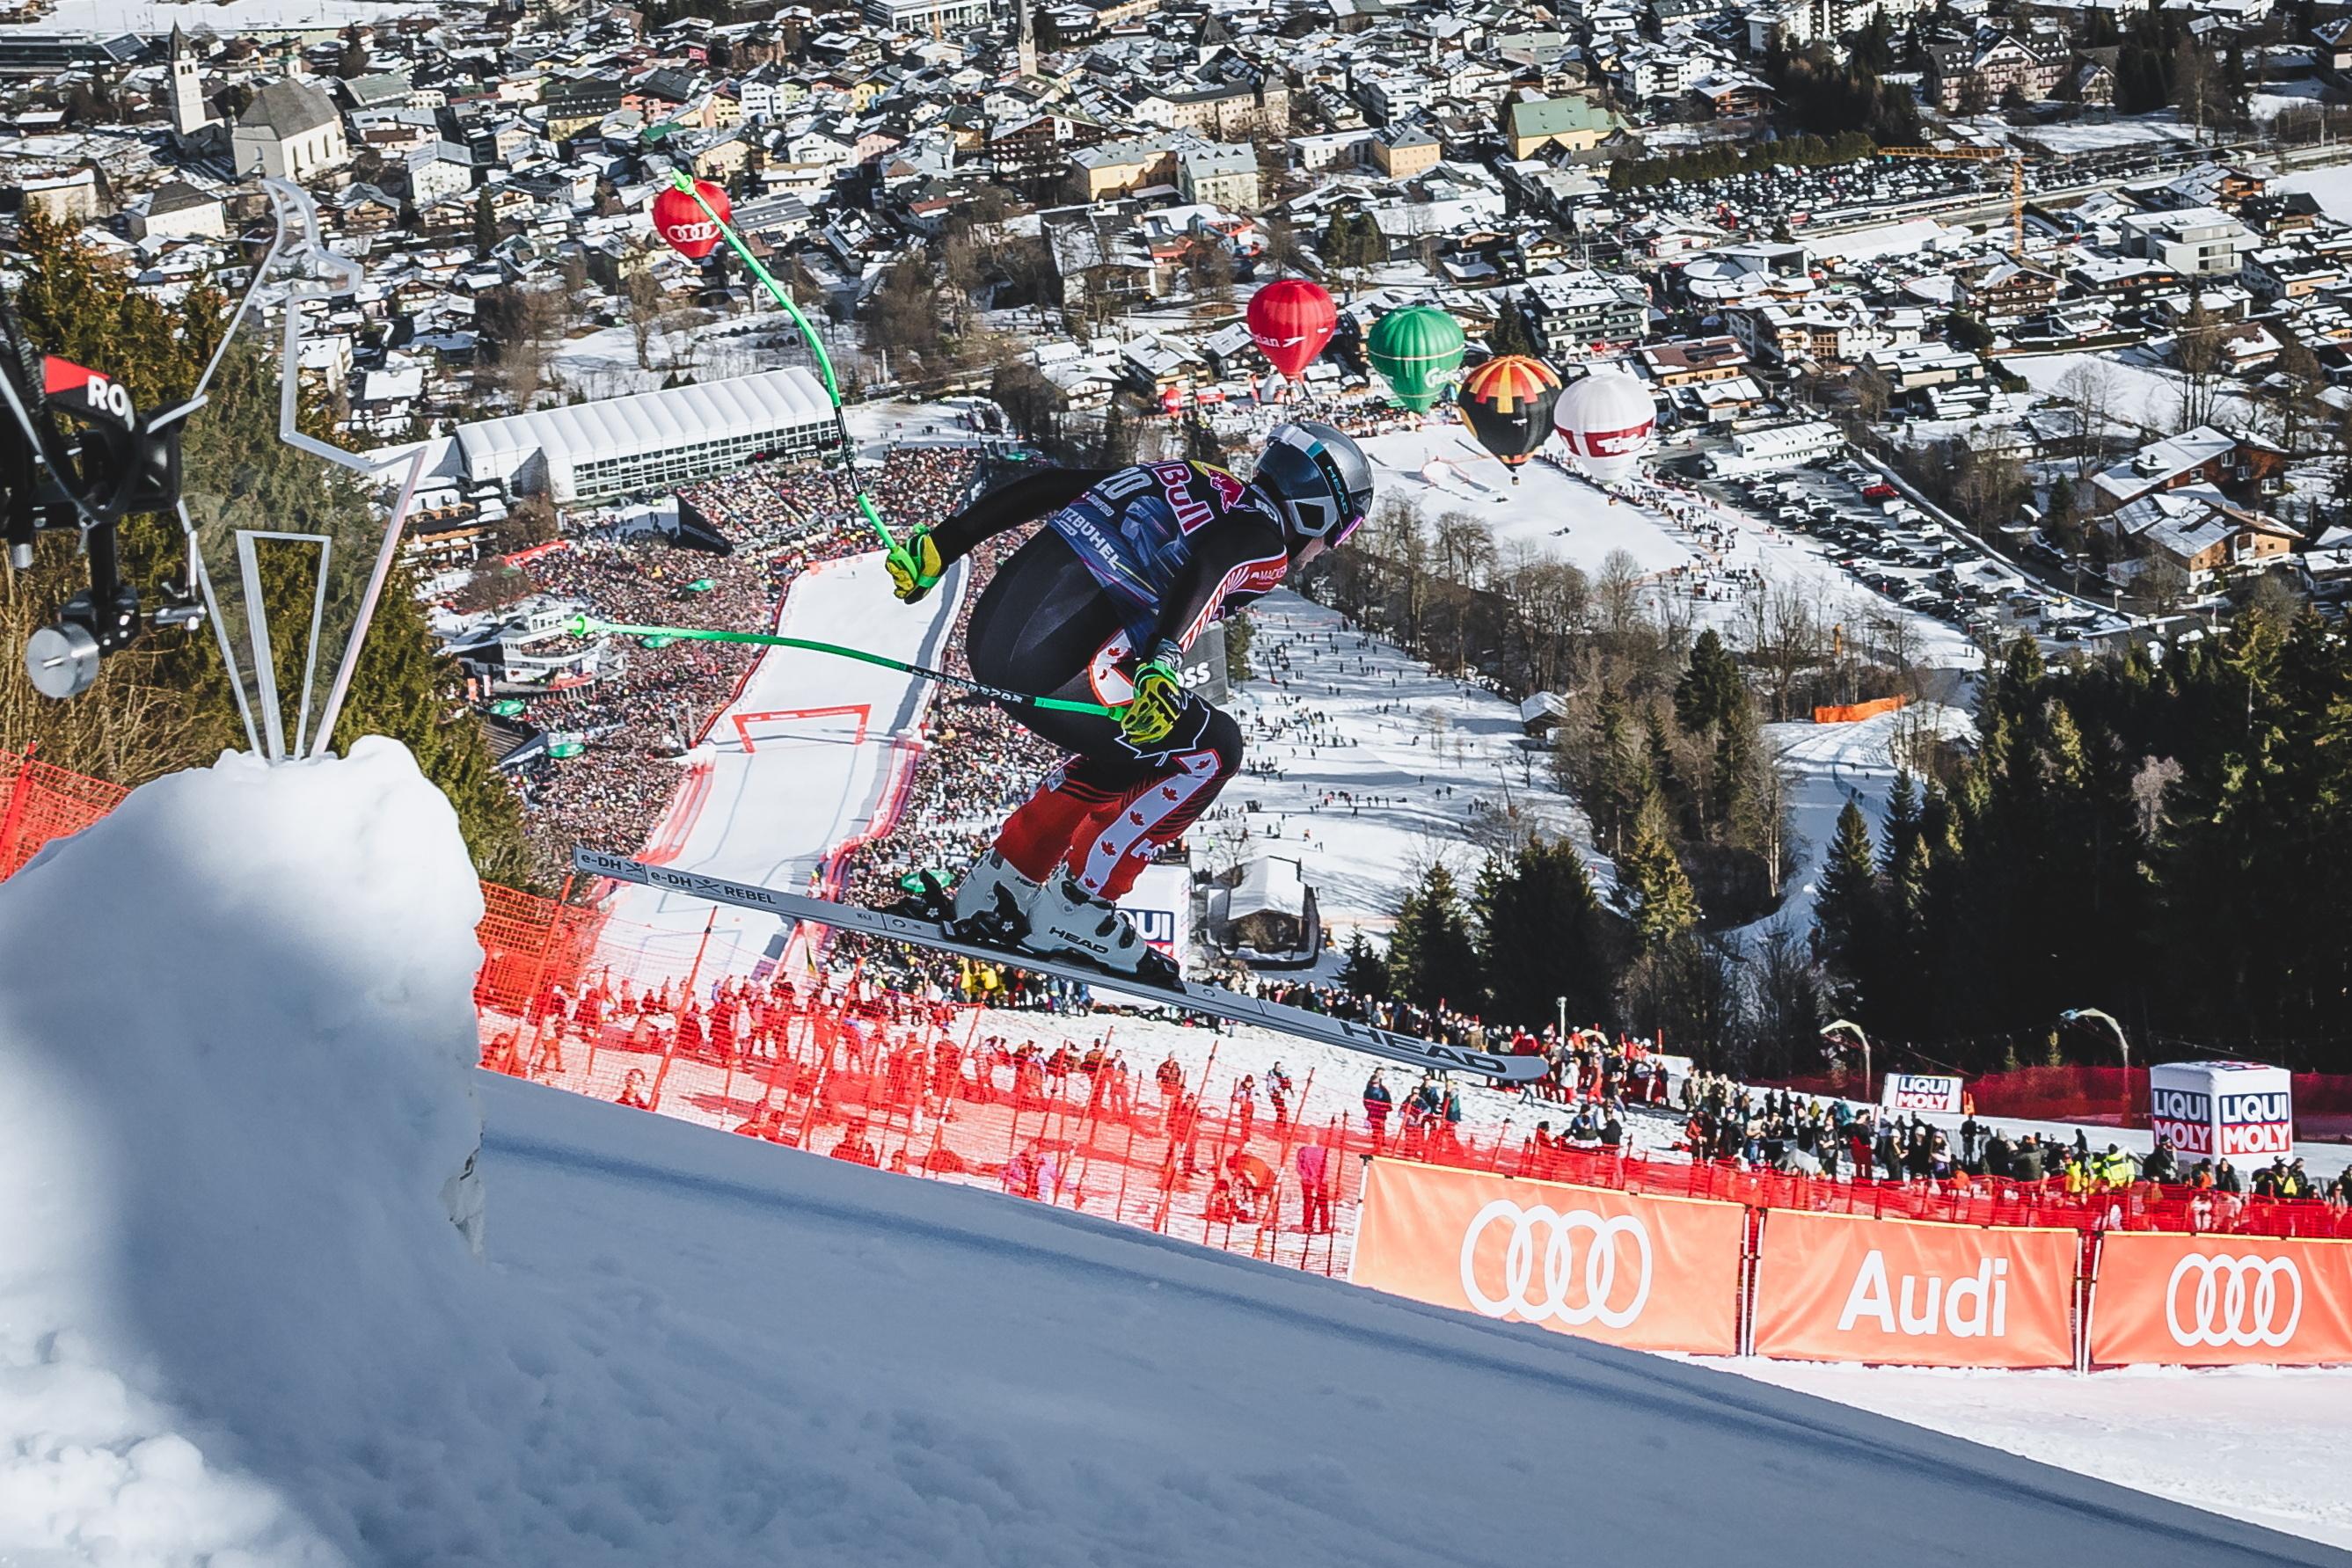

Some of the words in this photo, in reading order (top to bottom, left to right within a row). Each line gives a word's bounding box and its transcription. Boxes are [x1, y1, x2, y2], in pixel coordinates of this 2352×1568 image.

[1094, 466, 1152, 500] 20
[1326, 465, 1348, 514] HEAD
[1151, 463, 1215, 536] Bull
[581, 854, 622, 871] e-DH
[651, 870, 692, 887] e-DH
[724, 886, 777, 905] REBEL
[1049, 926, 1108, 954] HEAD
[1338, 1021, 1507, 1073] HEAD
[1897, 1092, 1948, 1109] MOLY
[1900, 1077, 1948, 1094] LIQUI
[2154, 1090, 2208, 1121] LIQUI
[2222, 1094, 2287, 1123] LIQUI
[2154, 1120, 2210, 1151] MOLY
[2222, 1124, 2290, 1154] MOLY
[1837, 1250, 2008, 1338] Audi
